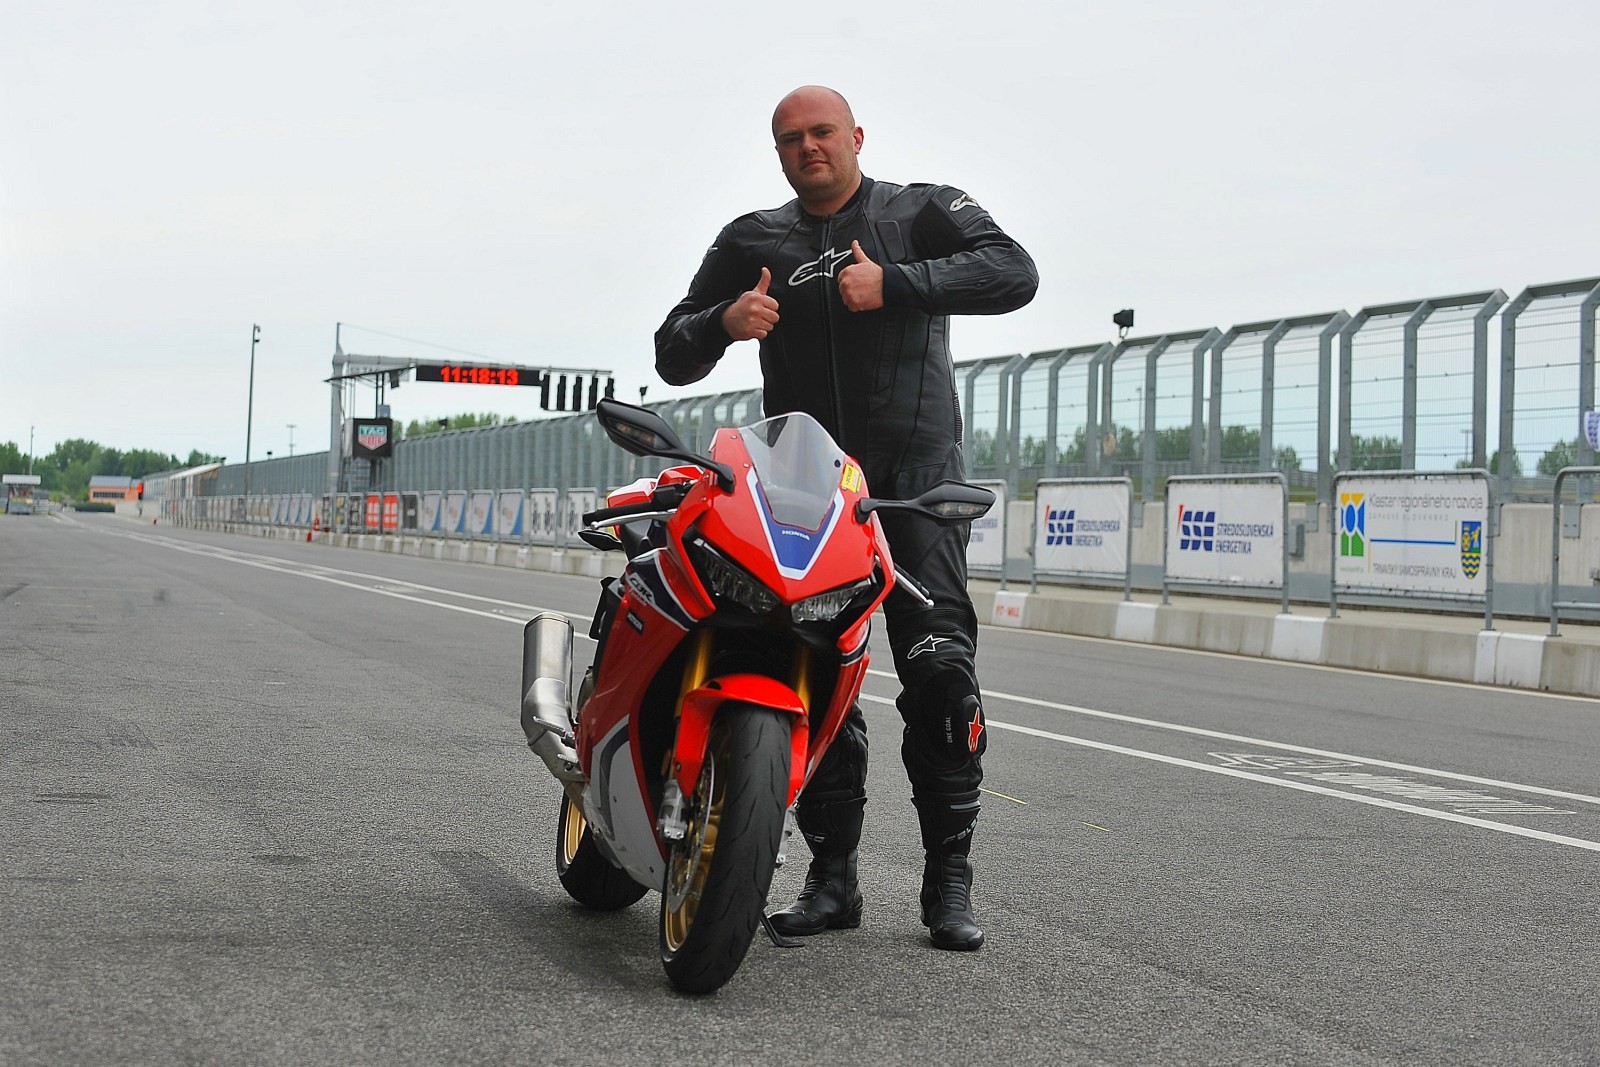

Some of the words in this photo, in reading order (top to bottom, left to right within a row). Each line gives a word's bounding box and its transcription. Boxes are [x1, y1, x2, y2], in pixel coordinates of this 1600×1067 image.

[440, 365, 519, 386] 11:18:13
[360, 426, 386, 435] TAG
[781, 529, 810, 540] HONDA
[1215, 539, 1252, 554] ENERGETIKA
[629, 577, 653, 603] CBR
